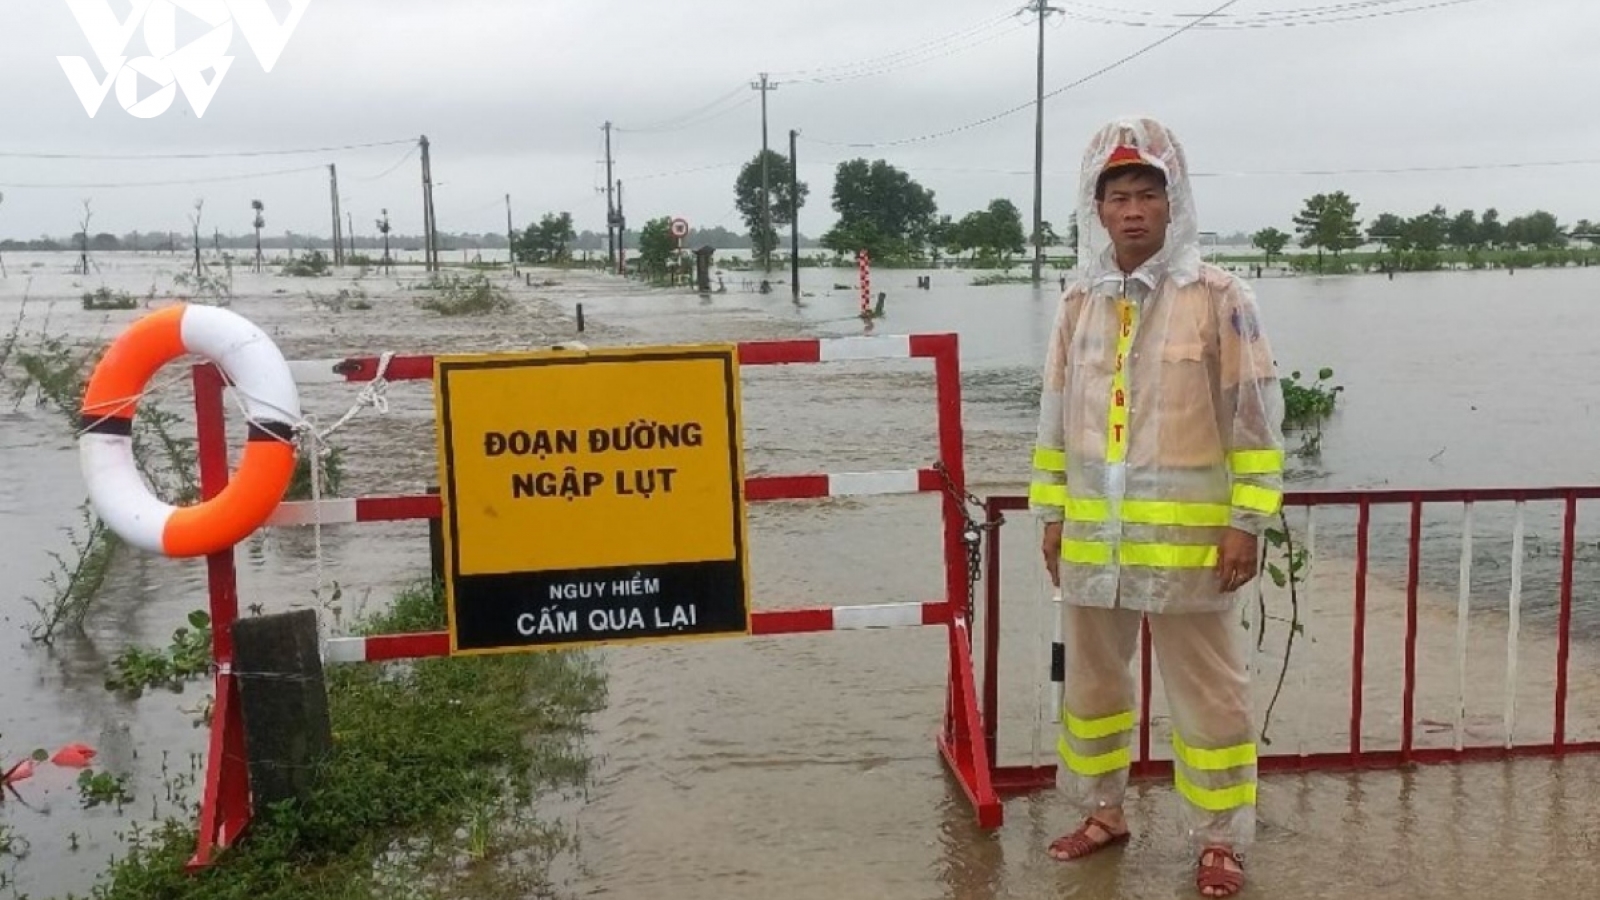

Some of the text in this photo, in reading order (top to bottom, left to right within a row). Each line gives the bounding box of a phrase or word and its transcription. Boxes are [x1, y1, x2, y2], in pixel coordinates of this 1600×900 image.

[484, 419, 702, 460] ĐOẠN ĐƯỜNG
[512, 466, 677, 501] NGẬP LỤT
[549, 571, 660, 600] NGUY HIỂM
[516, 604, 697, 635] CẤM QUA LẠI
